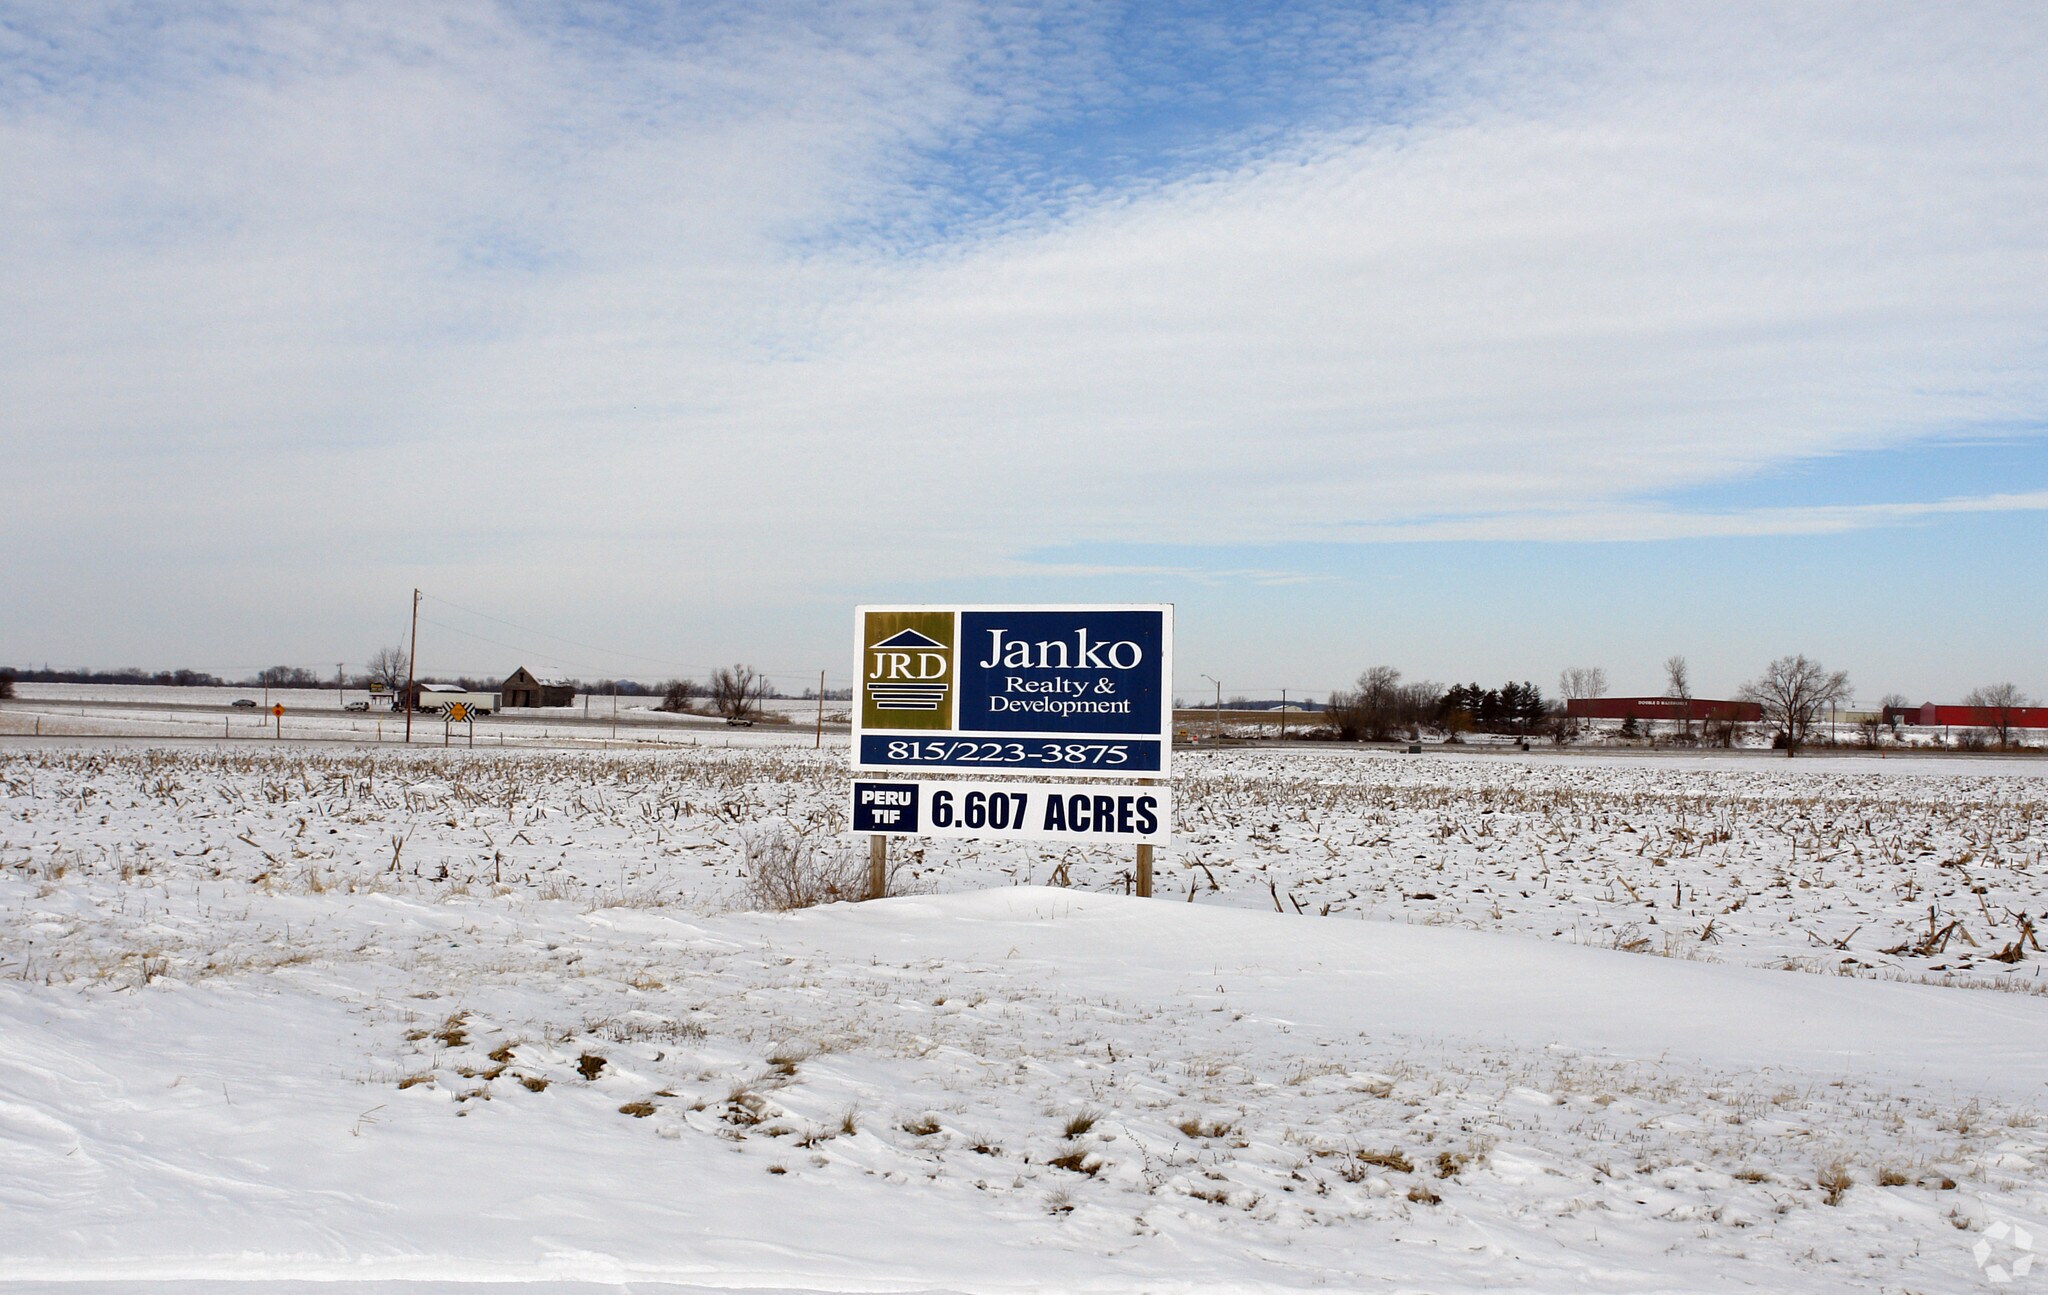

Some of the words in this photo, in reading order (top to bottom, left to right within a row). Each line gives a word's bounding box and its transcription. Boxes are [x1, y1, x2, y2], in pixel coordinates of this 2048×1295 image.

[979, 627, 1143, 670] Janko
[869, 652, 947, 680] JRD
[1004, 676, 1089, 698] Realty
[1094, 677, 1116, 694] &
[989, 695, 1131, 717] Development
[887, 740, 1129, 764] 815/223-3875
[861, 790, 912, 806] PERU
[871, 809, 901, 824] TIF
[931, 790, 1028, 830] 6.607
[1043, 793, 1158, 835] ACRES
